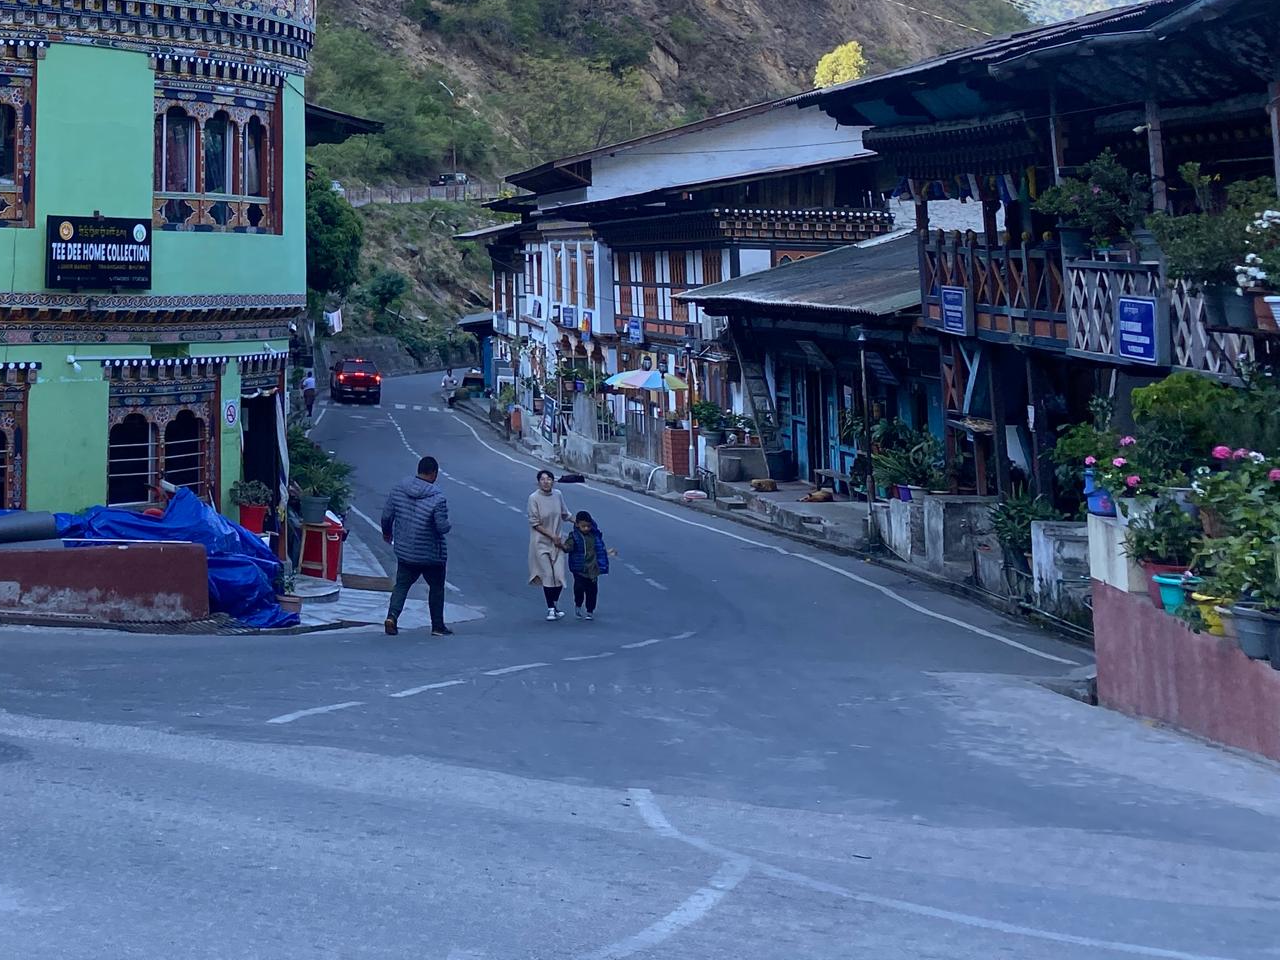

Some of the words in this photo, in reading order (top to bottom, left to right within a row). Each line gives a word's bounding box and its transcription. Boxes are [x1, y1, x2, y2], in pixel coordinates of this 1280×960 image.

[52, 242, 66, 260] TEE
[67, 242, 82, 261] DEE
[83, 243, 106, 261] HOME
[107, 243, 150, 262] COLLECTION
